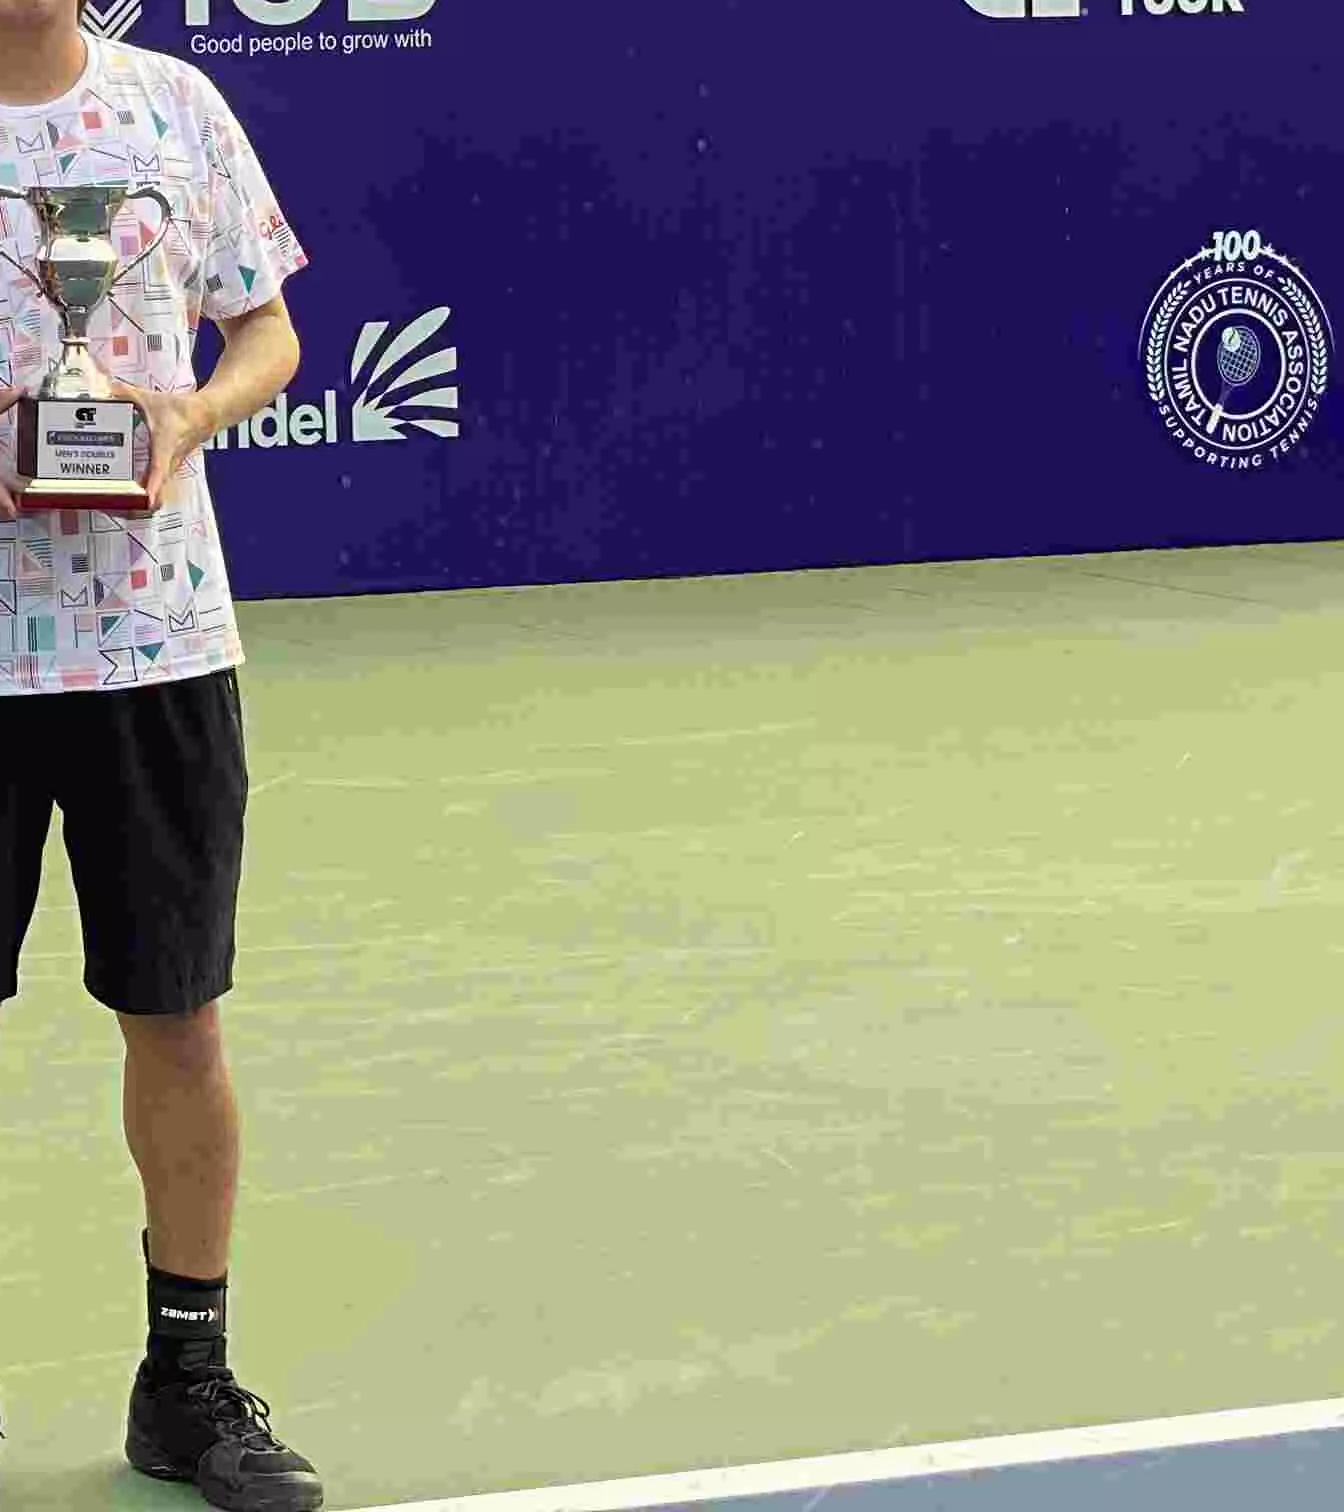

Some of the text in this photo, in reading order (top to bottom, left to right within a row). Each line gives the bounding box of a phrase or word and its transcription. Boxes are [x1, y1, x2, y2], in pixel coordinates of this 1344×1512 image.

[190, 28, 432, 57] Good people to grow with
[1212, 230, 1261, 261] 100
[1194, 262, 1275, 284] YEARS OF
[1172, 286, 1304, 442] TAMIL NADU TENNIS ASSOCIATION
[1160, 399, 1317, 469] SUPPORTING TENNIS
[60, 464, 110, 474] WINNER
